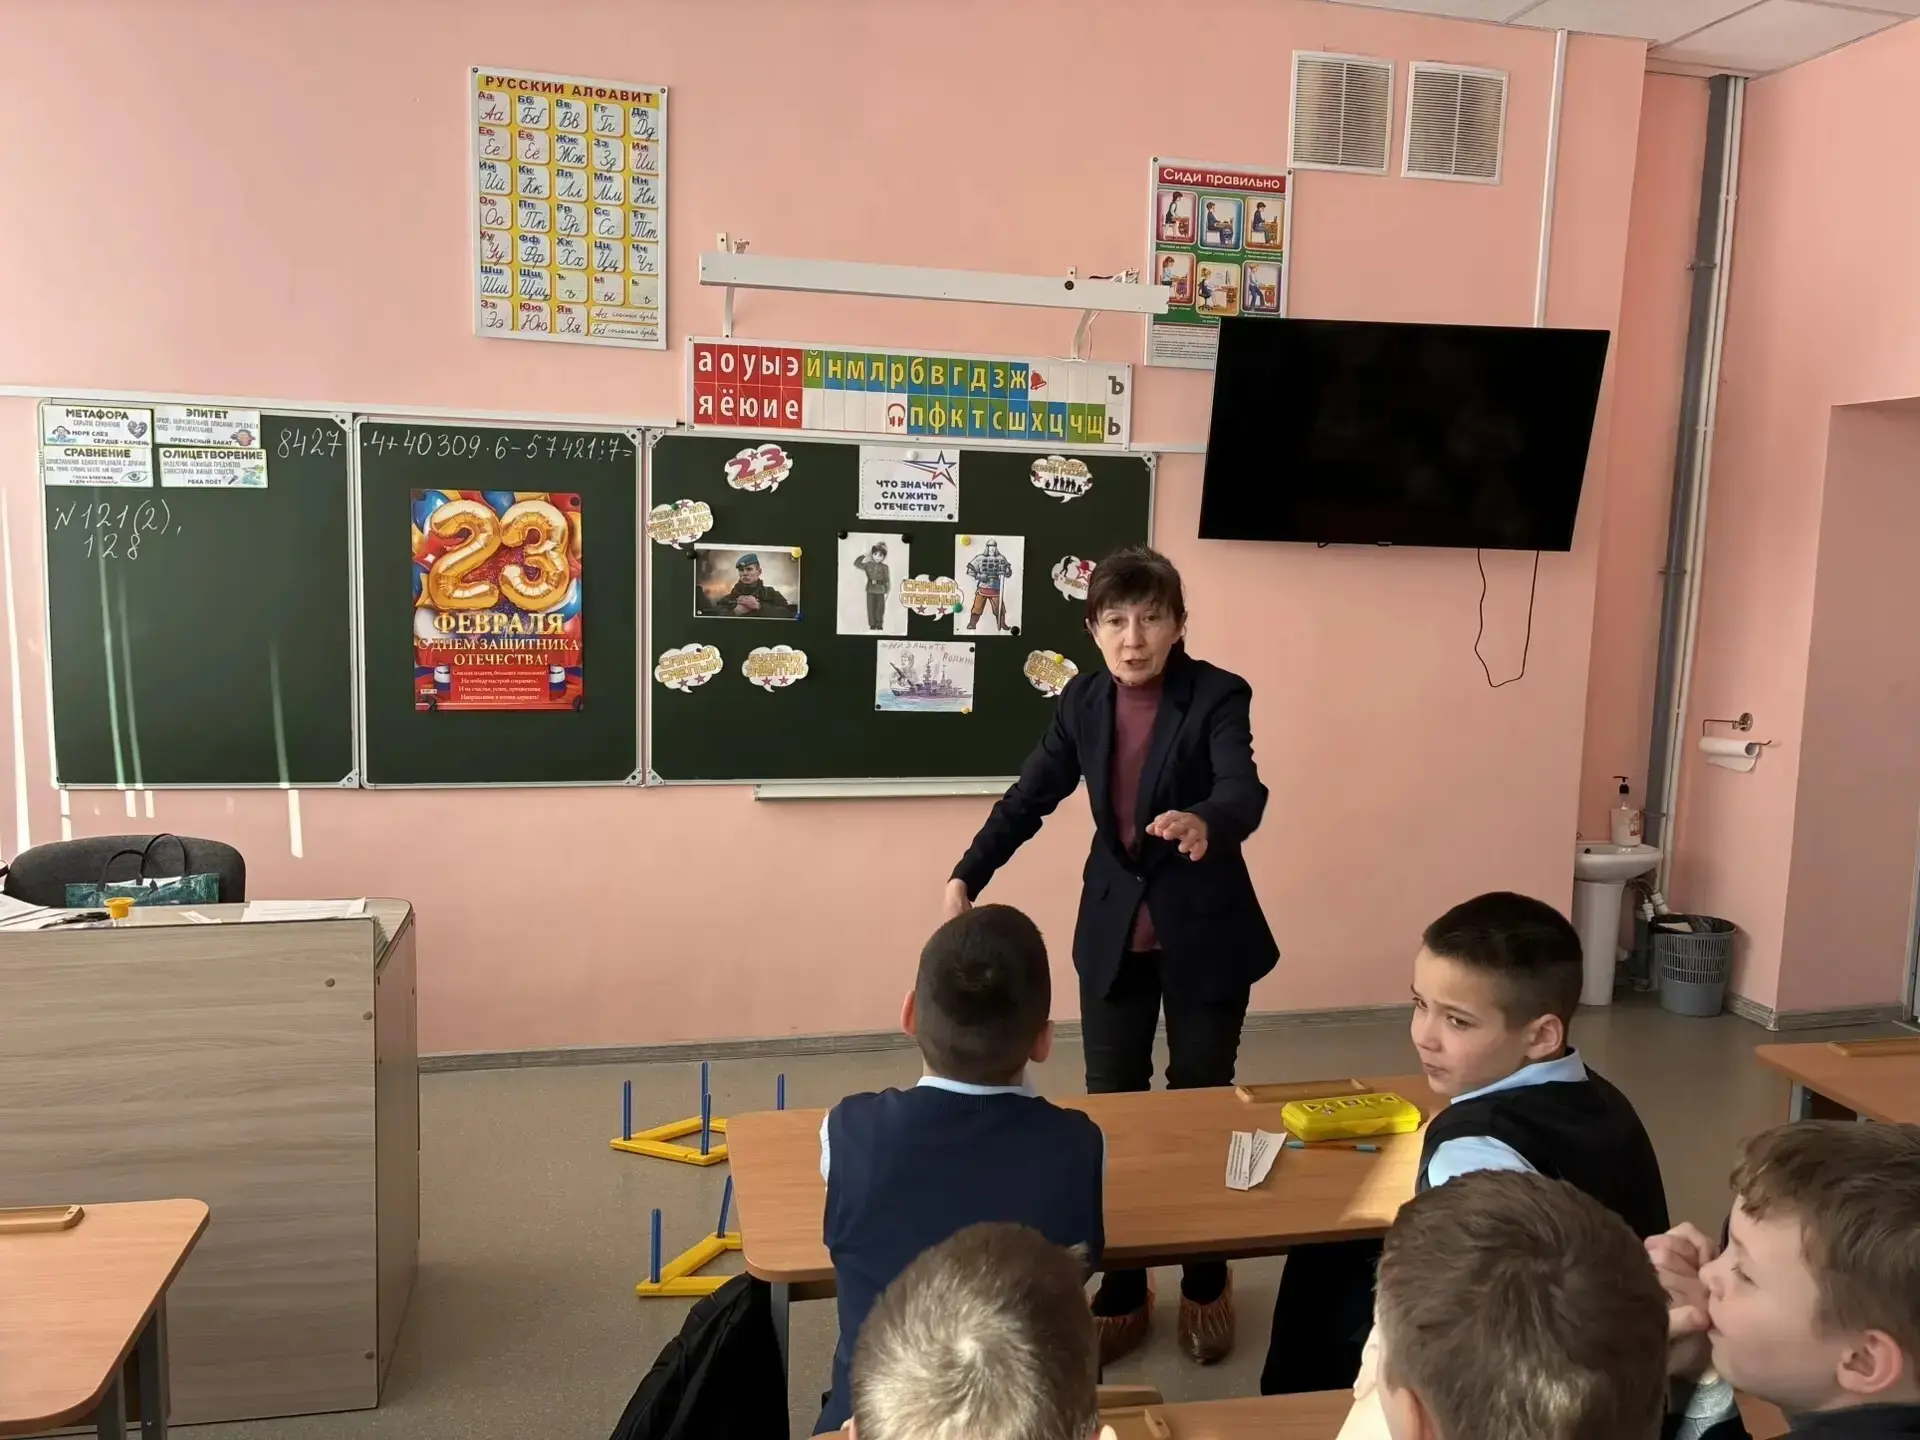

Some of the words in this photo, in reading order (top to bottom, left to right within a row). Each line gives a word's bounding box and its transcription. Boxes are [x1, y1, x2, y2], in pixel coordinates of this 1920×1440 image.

[478, 91, 494, 100] Аа
[518, 95, 533, 104] Бб
[485, 76, 564, 94] РУССКИЙ
[572, 86, 652, 103] АЛФАВИТ
[481, 104, 503, 121] Аа
[522, 108, 546, 124] Бб
[560, 112, 580, 128] Вв
[597, 115, 615, 133] Гг
[634, 119, 655, 141] Дд
[485, 138, 500, 156] Ее
[556, 146, 585, 165] Жж
[600, 150, 616, 172] Зз
[636, 153, 655, 170] Ии
[1163, 168, 1202, 183] Сиди
[1206, 173, 1280, 189] правильно
[523, 177, 543, 194] Кк
[558, 181, 582, 198] Лл
[594, 185, 622, 201] Мм
[634, 188, 656, 204] Нн
[485, 208, 504, 225] Оо
[521, 211, 546, 229] Пп
[560, 215, 579, 238] Рр
[598, 219, 615, 235] Сс
[632, 222, 657, 239] Тт
[487, 243, 504, 265] Уу
[521, 246, 545, 269] Фф
[559, 249, 584, 266] Хх
[598, 252, 618, 273] Цц
[638, 255, 654, 272] Чч
[482, 276, 508, 294] Шш
[519, 279, 549, 301] Щщ
[520, 302, 543, 312] Юю
[486, 311, 503, 328] Ээ
[521, 314, 547, 332] Юю
[561, 317, 581, 334] Яя
[66, 409, 129, 420] МЕТАФОРА
[186, 409, 228, 419] ЭПИТЕТ
[64, 448, 131, 458] СРАВНЕНИЕ
[278, 428, 342, 458] 8427
[163, 450, 263, 460] ОЛИЦЕТВОРЕНИЕ
[876, 480, 898, 489] ЧТО
[901, 480, 944, 490] ЗНАЧИТ
[881, 491, 938, 500] СЛУЖИТЬ
[874, 502, 945, 512] ОТЕЧЕСТВУ?
[84, 533, 140, 560] 128
[428, 499, 570, 611] 23
[904, 581, 956, 593] САМЫЙ
[433, 612, 564, 635] ФЕВРАЛЯ
[418, 639, 430, 650] С
[480, 639, 580, 652] ЗАЩИТНИКА
[454, 653, 548, 666] ОТЕЧЕСТВА!
[660, 647, 716, 669] САМЫЙ
